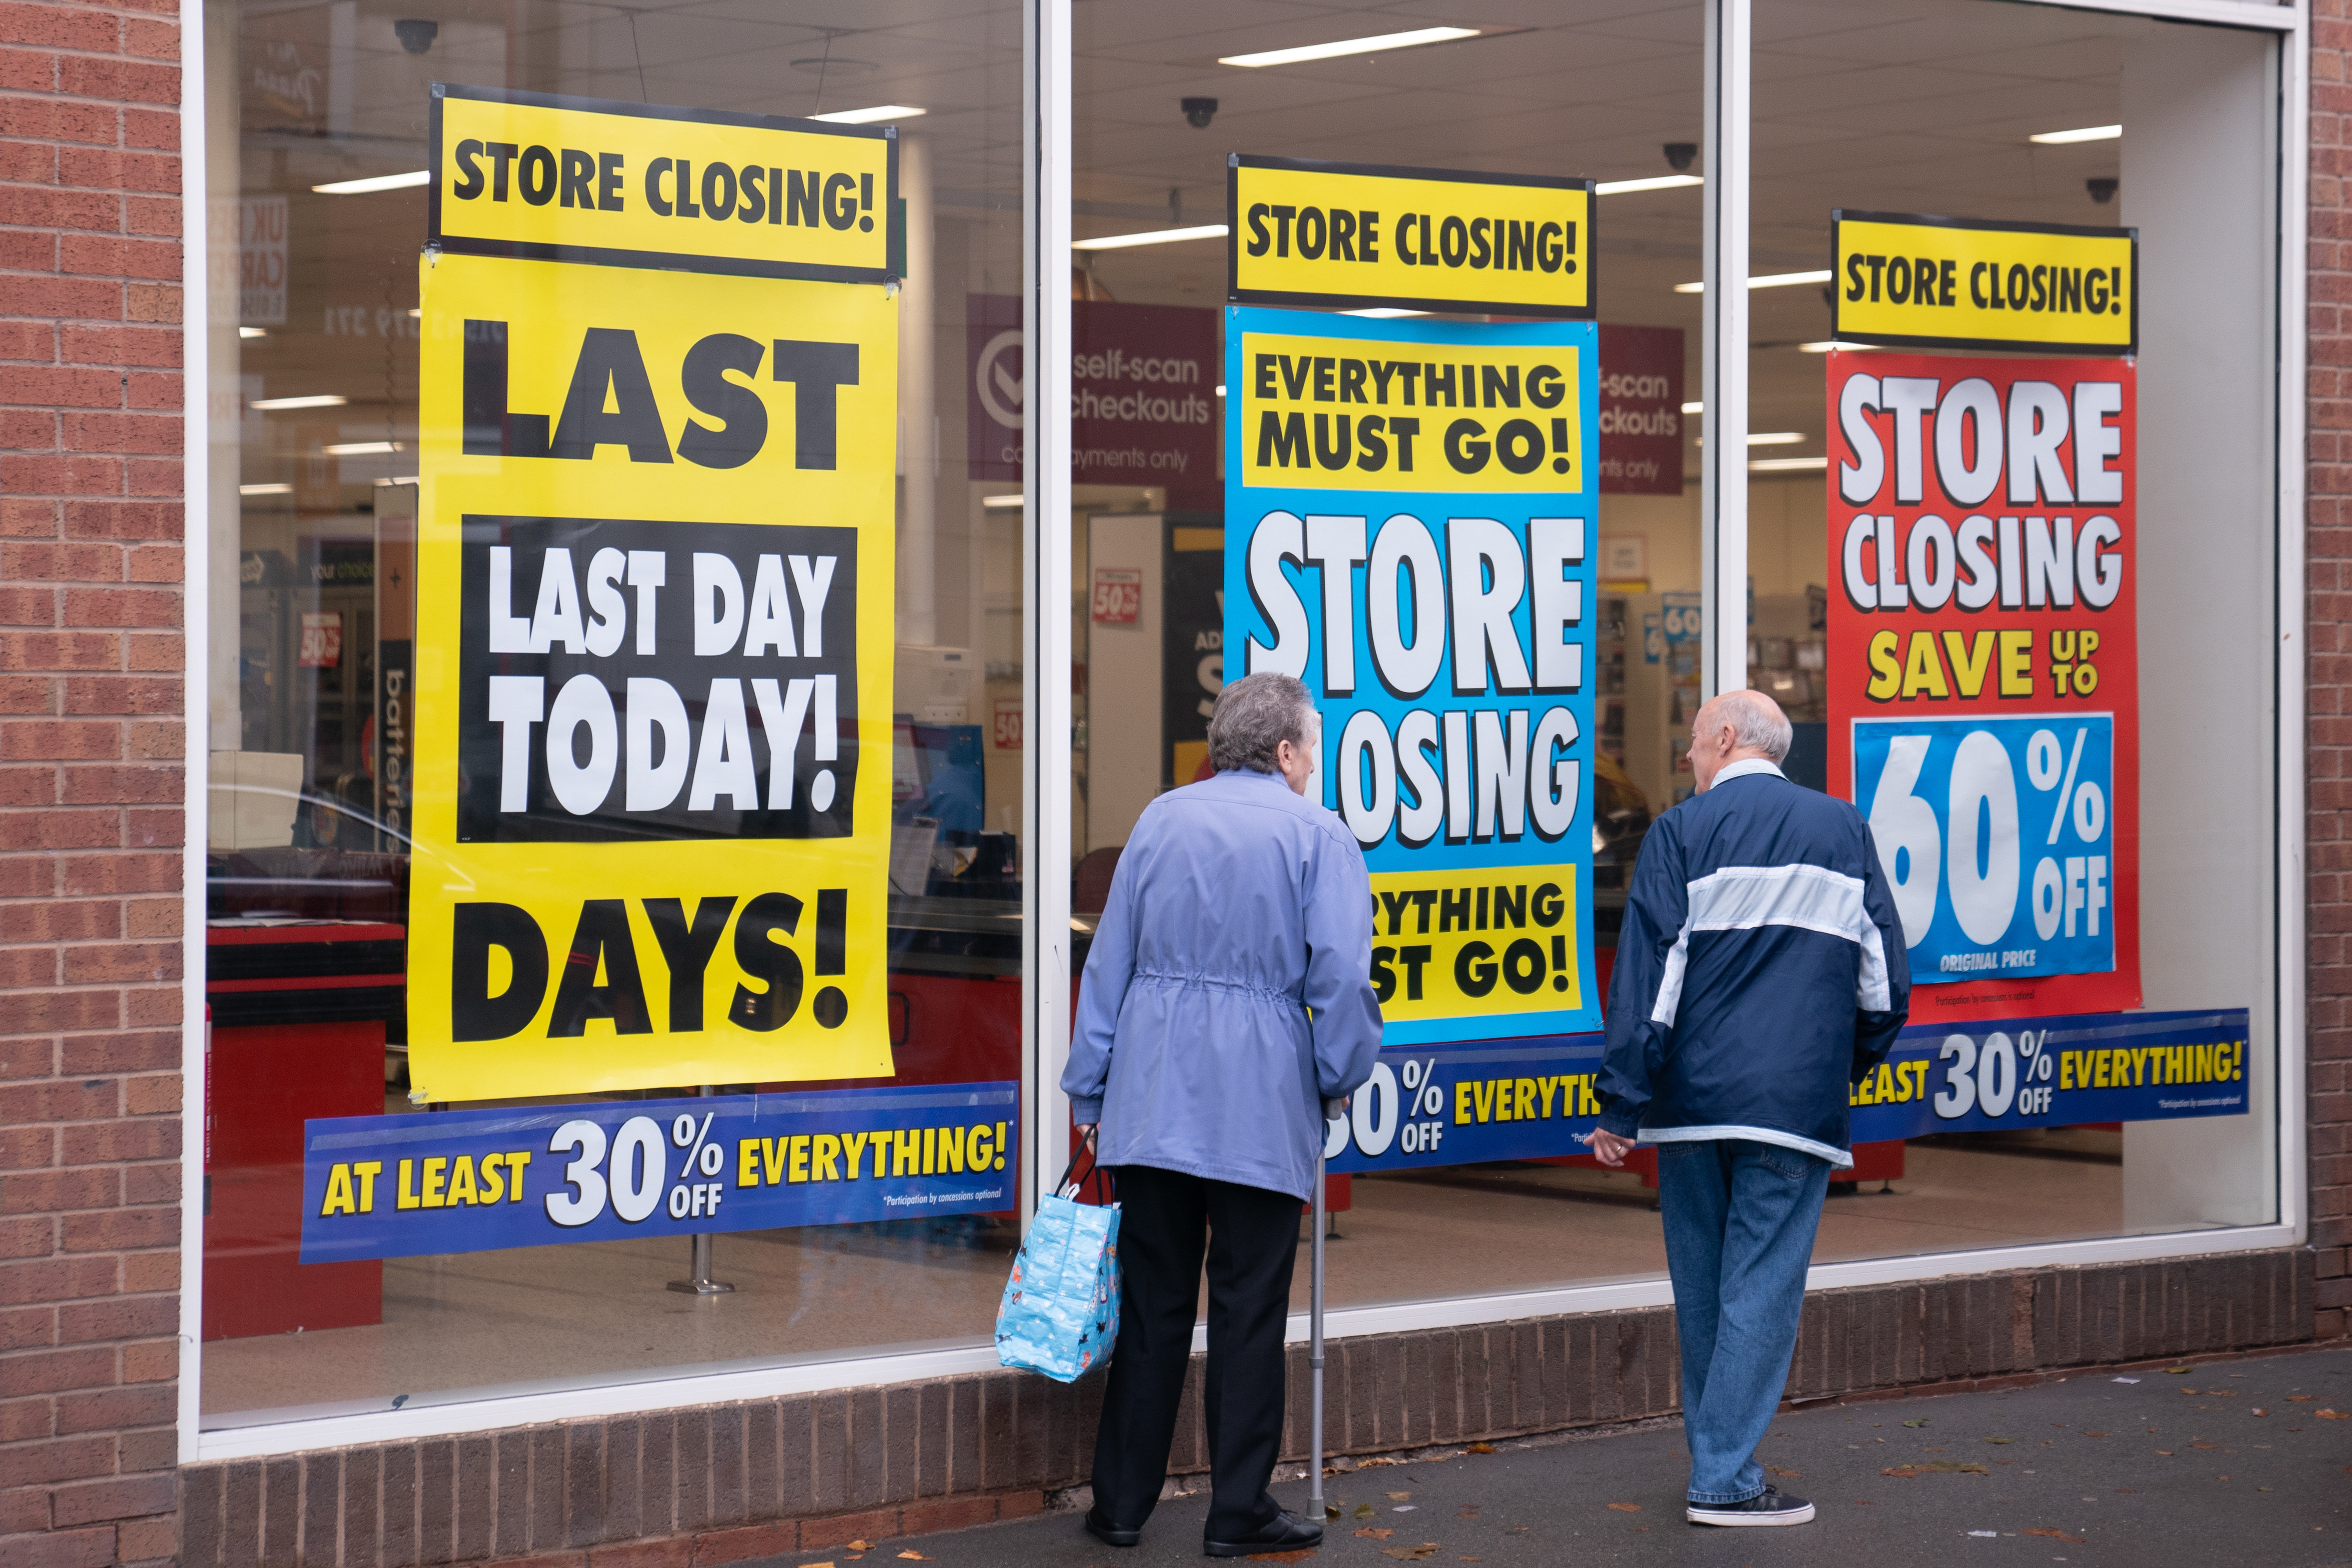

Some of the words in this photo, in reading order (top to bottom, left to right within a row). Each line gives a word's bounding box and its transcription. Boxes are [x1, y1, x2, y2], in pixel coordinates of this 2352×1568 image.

[454, 138, 624, 212] STORE
[644, 156, 875, 233] CLOSING!
[1247, 203, 1379, 263] STORE
[1395, 213, 1577, 274] CLOSING!
[1847, 253, 1956, 307] STORE
[1970, 261, 2121, 316] CLOSING!
[463, 318, 859, 470] LAST
[1073, 348, 1199, 384] self-scan
[1255, 353, 1565, 409] EVERYTHING
[1150, 450, 1189, 473] only
[1256, 410, 1420, 473] MUST
[1444, 417, 1570, 475] GO!
[1627, 458, 1660, 483] only
[1838, 372, 2123, 508] STORE
[1841, 513, 2122, 613] CLOSING
[490, 547, 666, 657] LAST
[693, 552, 837, 657] DAY
[1244, 509, 1586, 702] STORE
[1865, 630, 2034, 703] SAVE
[2050, 630, 2100, 662] UP
[2051, 663, 2099, 697] TO
[386, 669, 404, 854] batteries
[489, 674, 838, 815] TODAY!
[1371, 883, 1565, 936] YTHING
[2032, 856, 2107, 941] OFF
[451, 888, 848, 1043] DAYS!
[1454, 935, 1569, 998] GO!
[1940, 952, 1998, 972] ORIGINAL
[2001, 949, 2036, 968] PRICE
[1325, 1058, 1444, 1159] 0%
[2018, 1087, 2053, 1115] OFF
[1401, 1122, 1443, 1153] OFF
[319, 1161, 381, 1217] AT
[396, 1151, 531, 1211] LEAST
[668, 1183, 722, 1219] OFF
[929, 1192, 937, 1205] by
[938, 1191, 974, 1203] concessions
[975, 1187, 1002, 1201] optional
